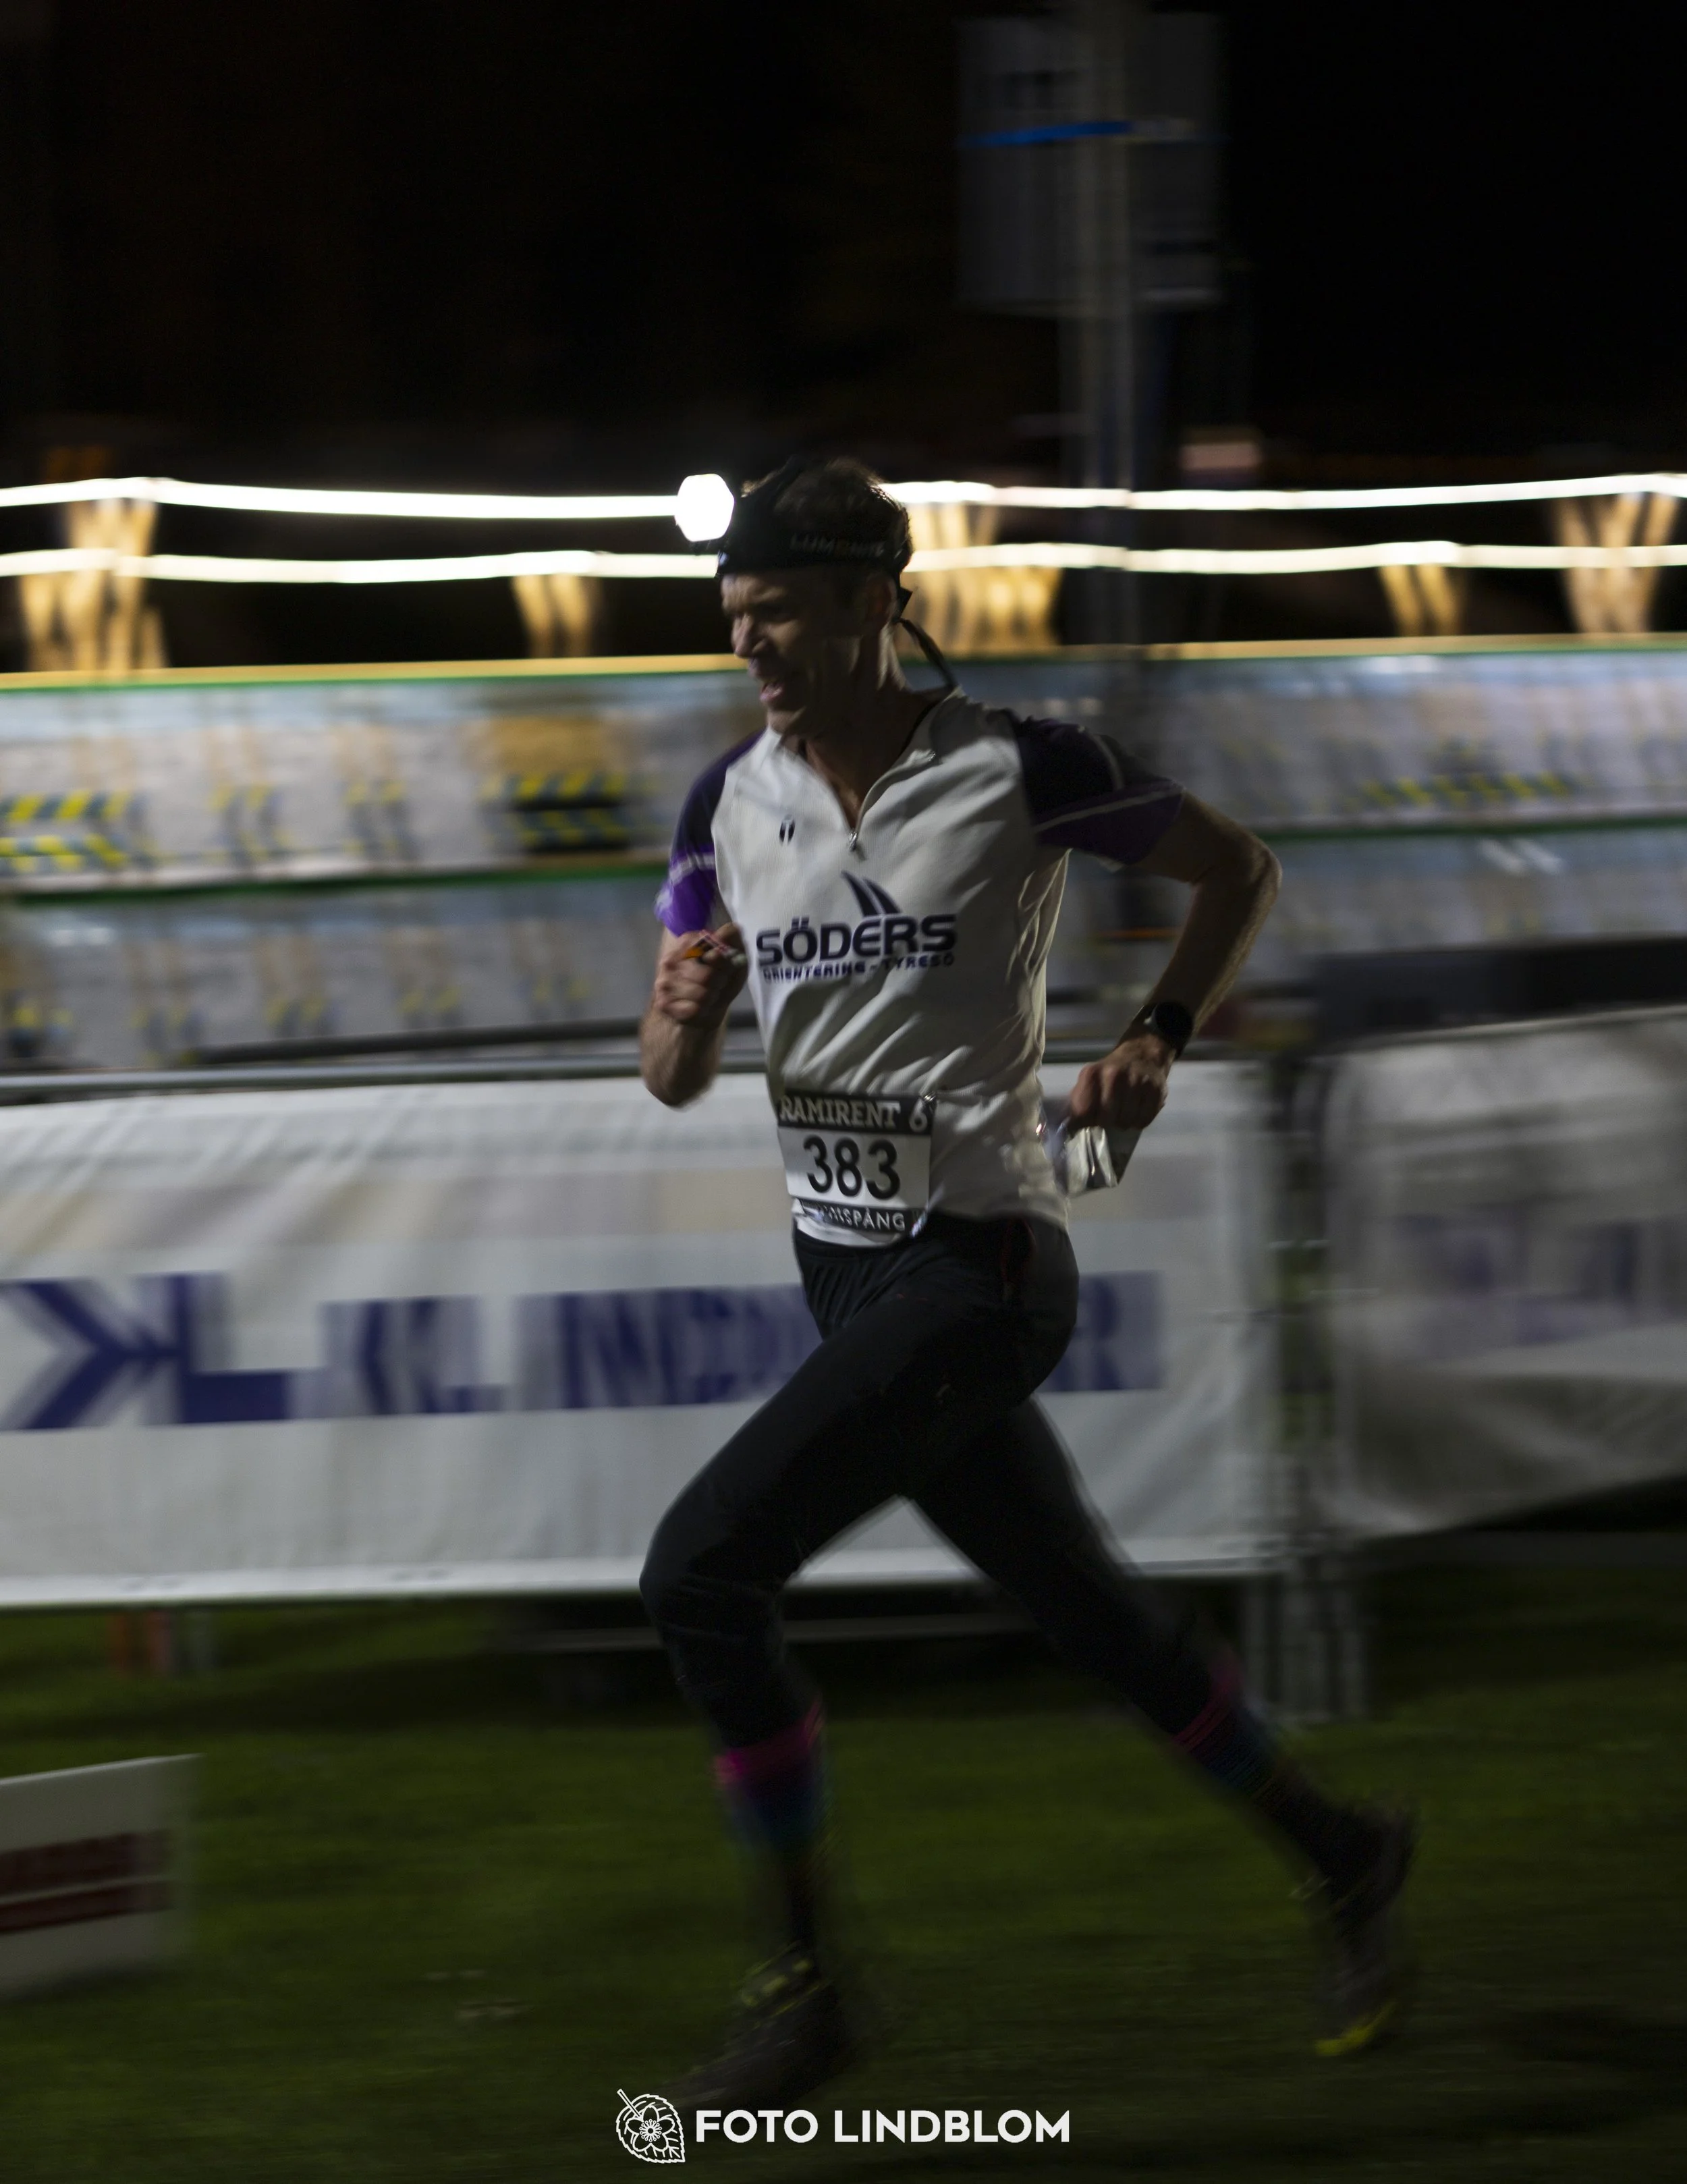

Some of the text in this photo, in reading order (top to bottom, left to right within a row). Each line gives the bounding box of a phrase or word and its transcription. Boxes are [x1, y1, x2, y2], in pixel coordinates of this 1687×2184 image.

[756, 914, 956, 966] SÖDERS
[883, 952, 954, 970] TYRESÖ
[779, 1094, 902, 1130] RAMIRENT
[804, 1135, 901, 1199] 383
